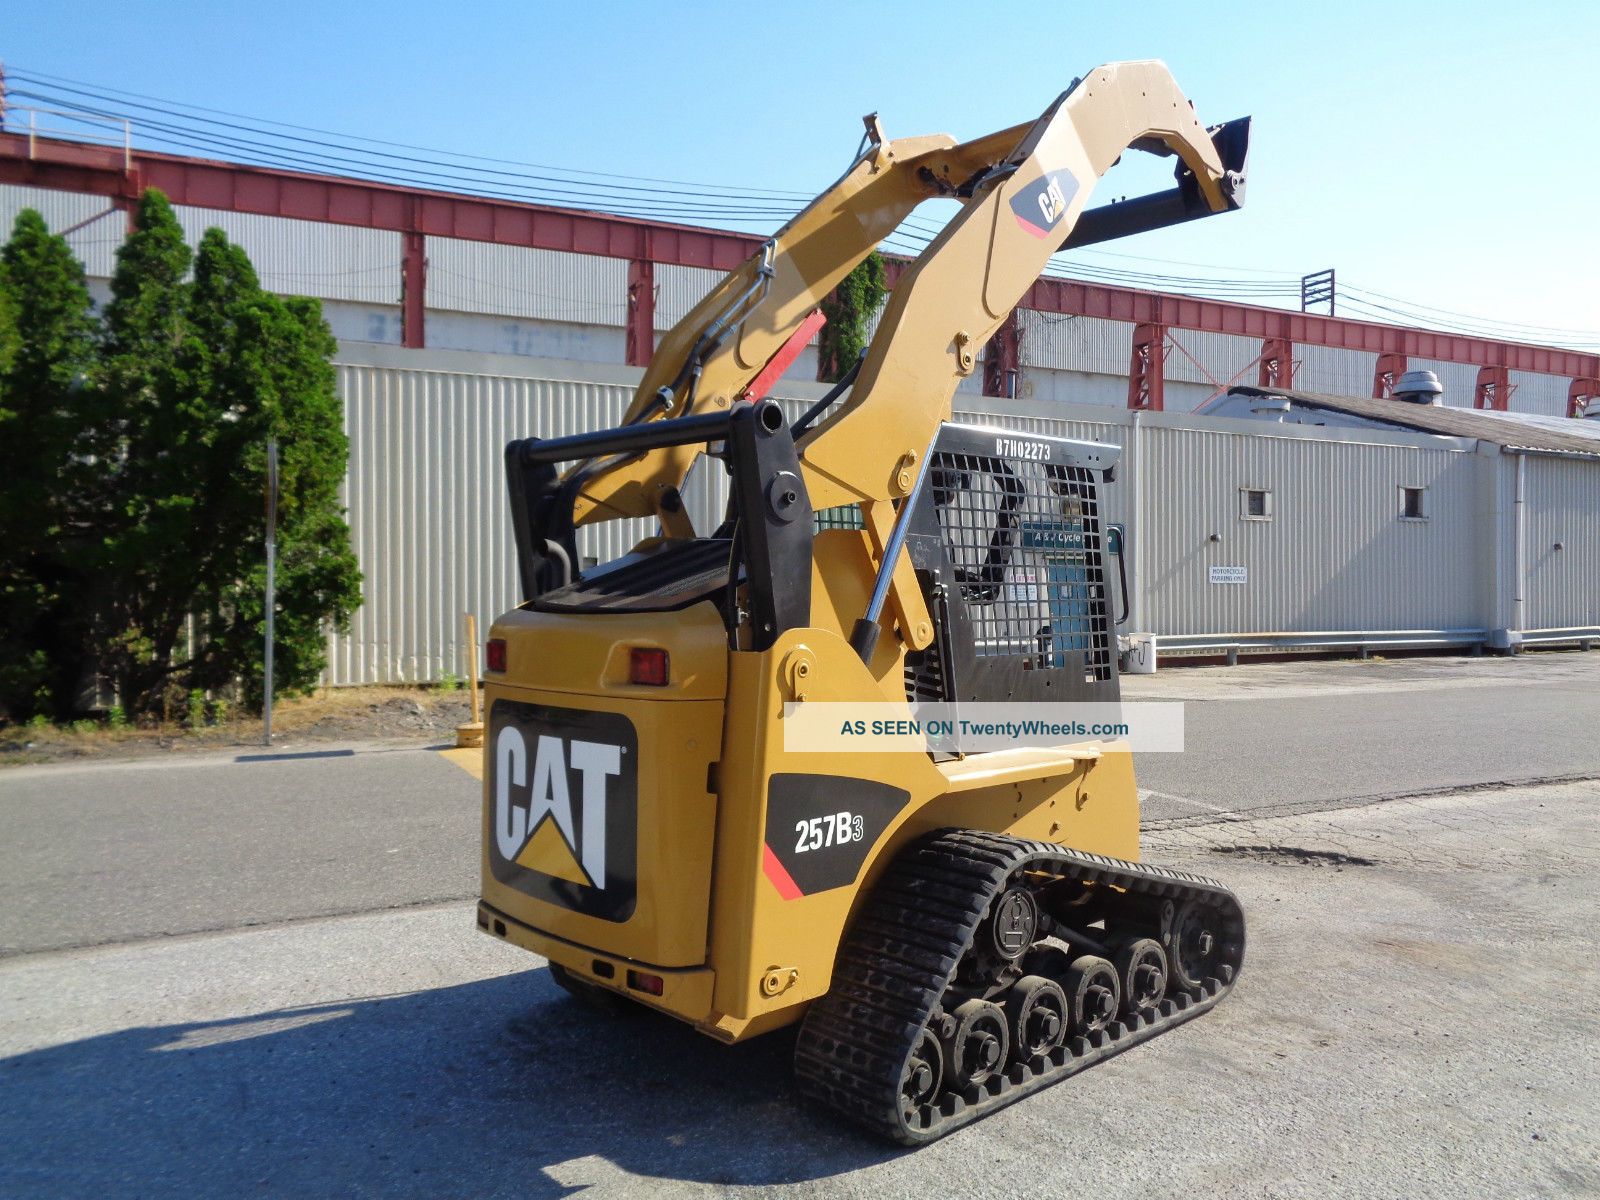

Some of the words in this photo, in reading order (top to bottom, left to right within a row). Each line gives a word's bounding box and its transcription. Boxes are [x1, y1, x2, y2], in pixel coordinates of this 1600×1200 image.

[1038, 175, 1067, 223] CAT
[996, 438, 1051, 460] B7H02273
[1058, 533, 1080, 544] Cycle
[496, 726, 621, 890] CAT
[795, 811, 864, 853] 257B3
